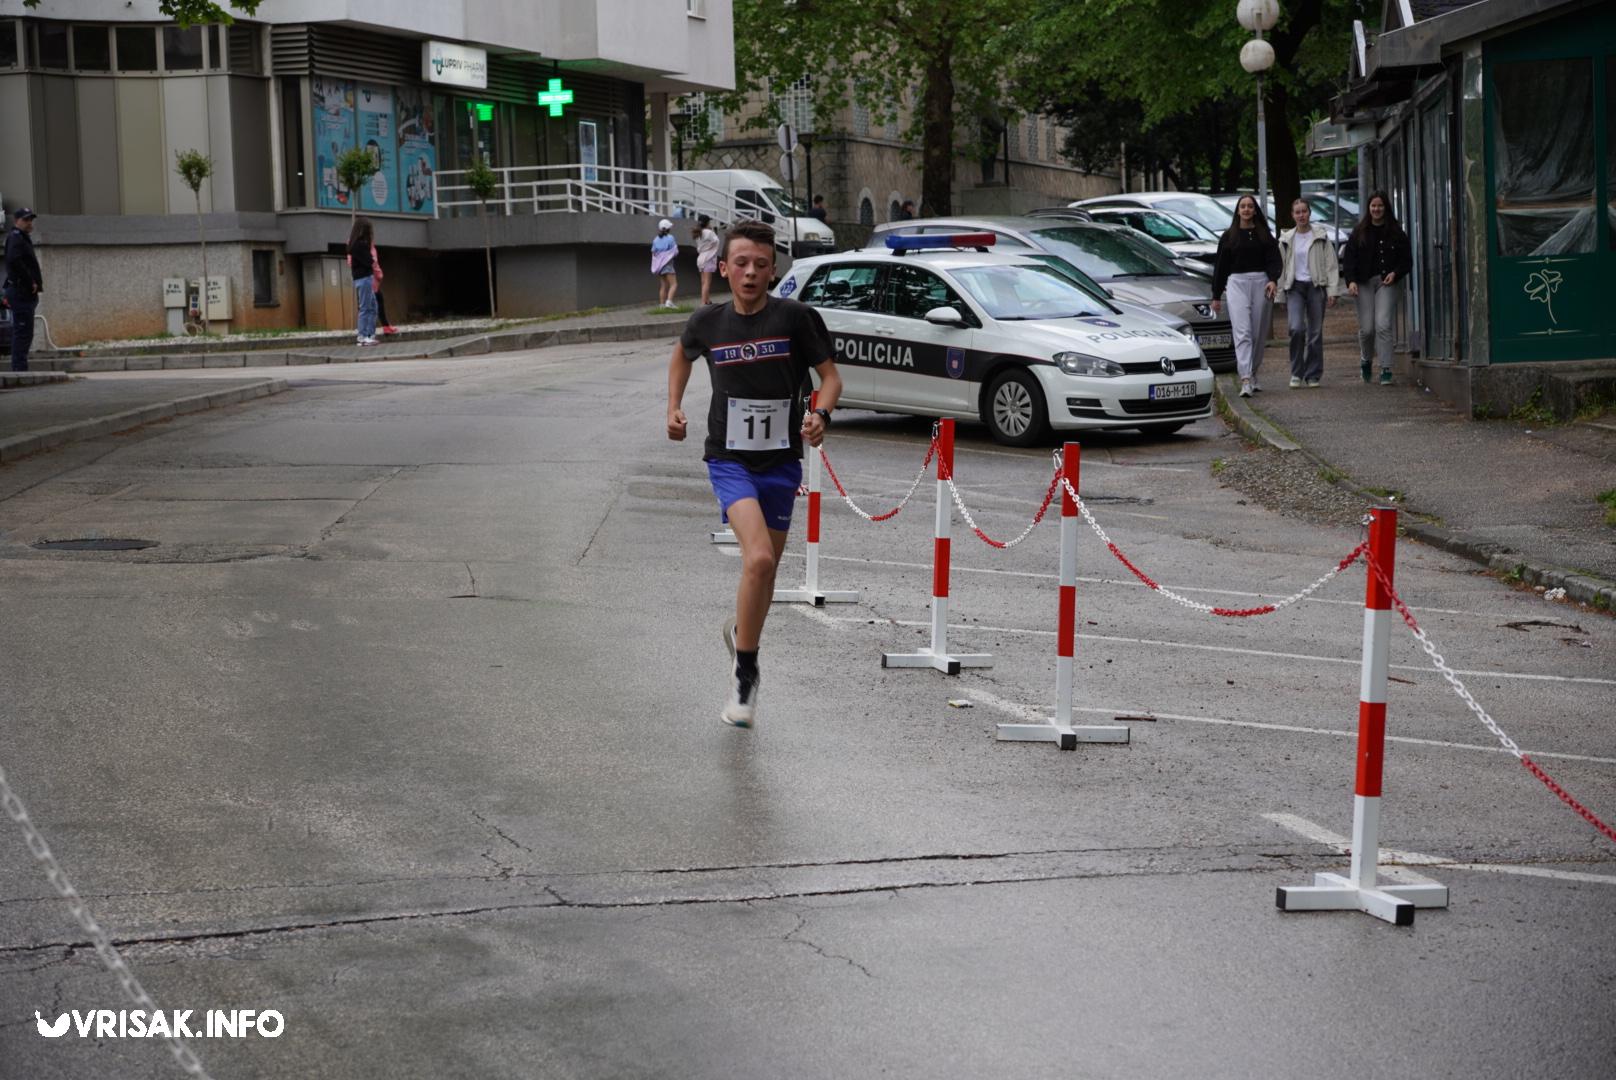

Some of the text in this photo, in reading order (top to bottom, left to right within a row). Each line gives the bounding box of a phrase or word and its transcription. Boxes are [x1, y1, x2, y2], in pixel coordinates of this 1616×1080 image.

[1087, 329, 1178, 344] POLICIJA
[834, 337, 914, 367] POLICIJA
[1155, 384, 1195, 398] 016-M-118
[743, 415, 771, 440] 11
